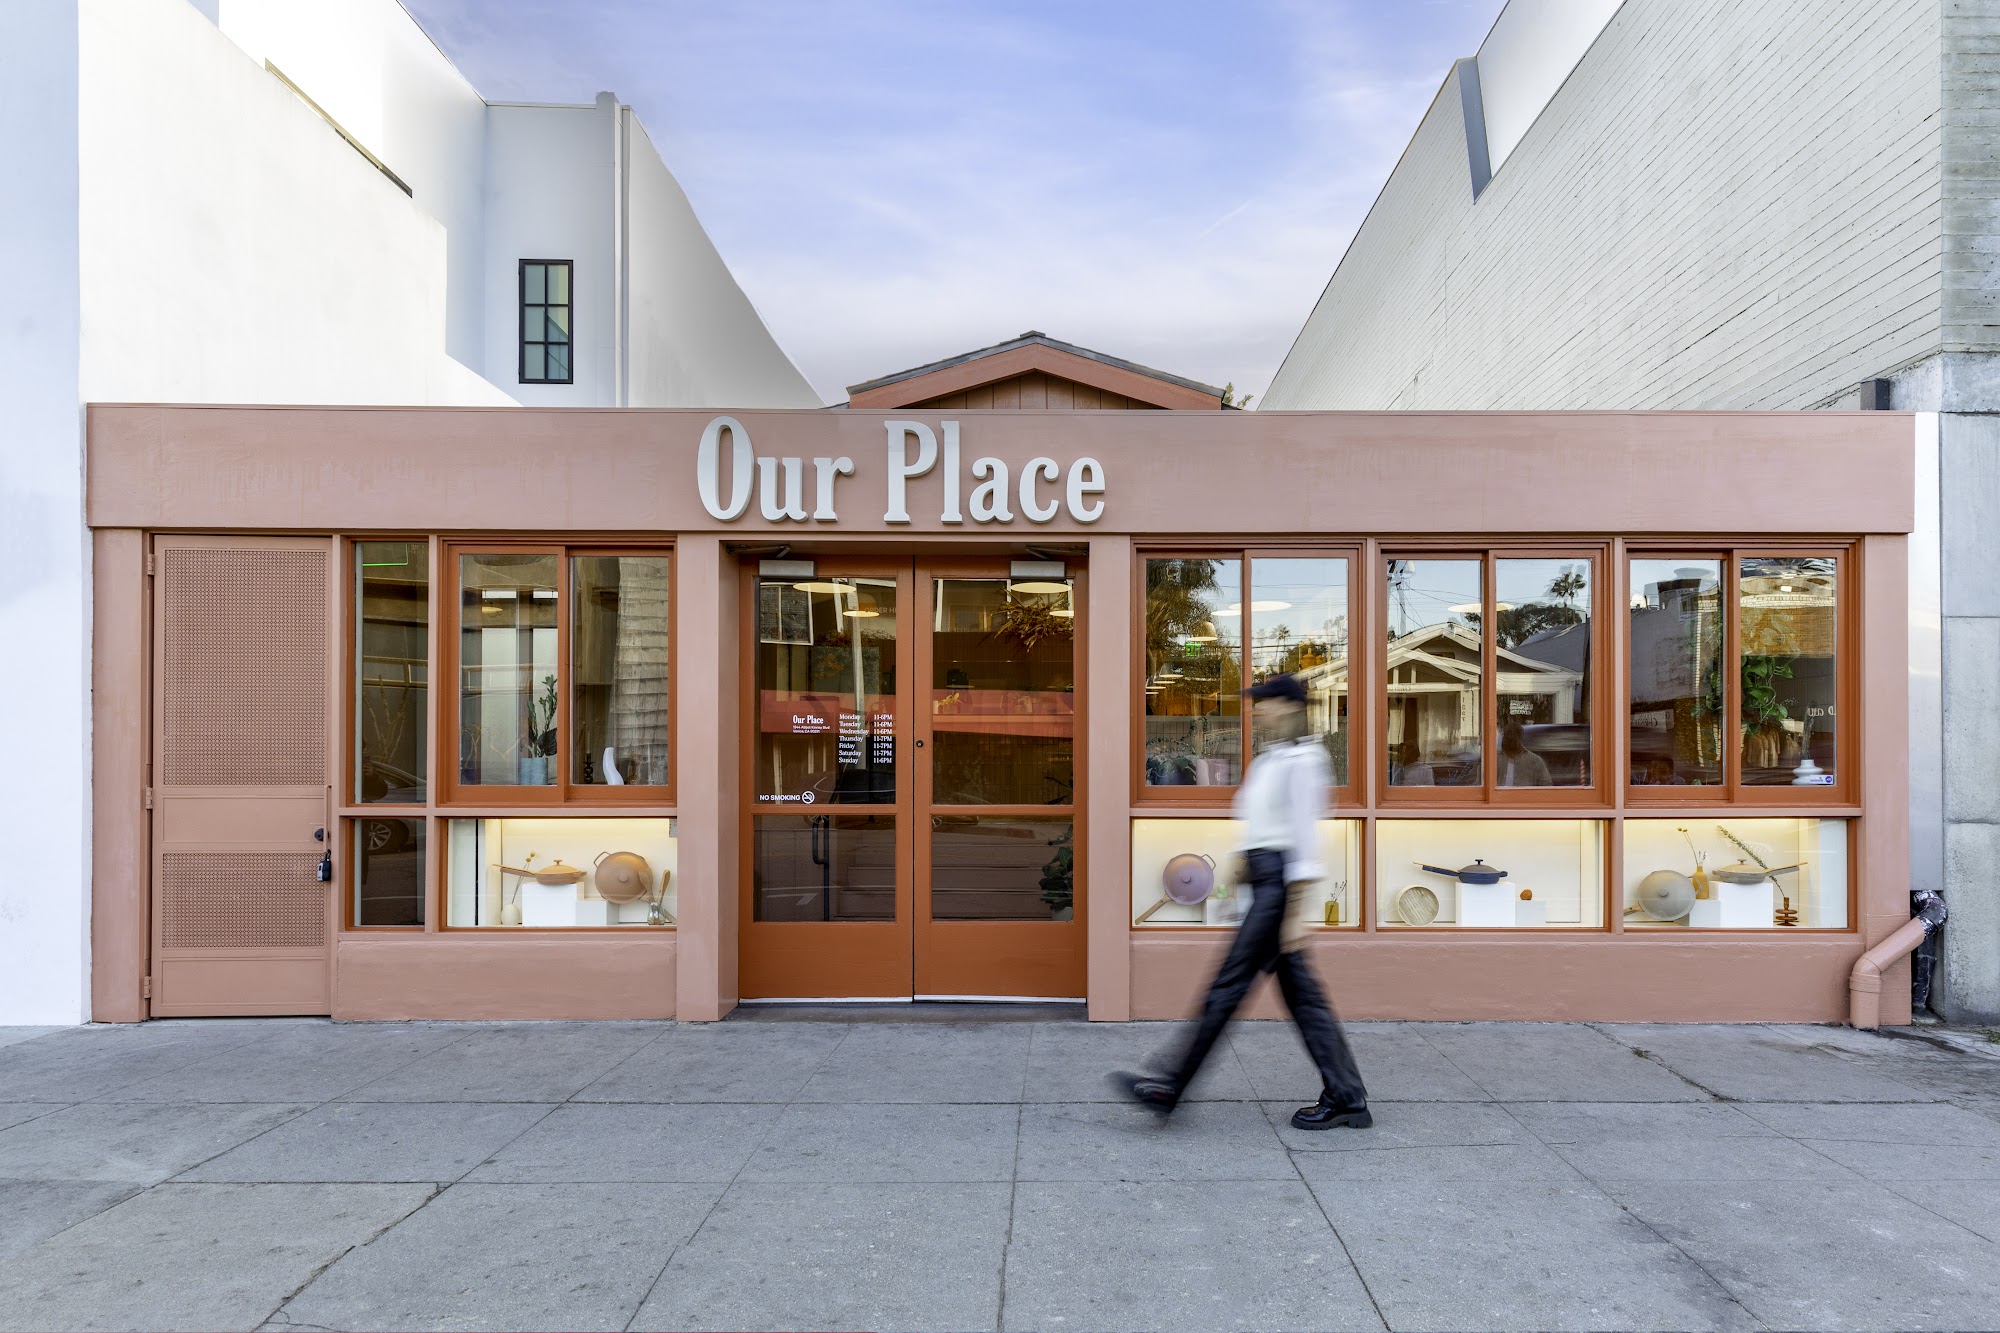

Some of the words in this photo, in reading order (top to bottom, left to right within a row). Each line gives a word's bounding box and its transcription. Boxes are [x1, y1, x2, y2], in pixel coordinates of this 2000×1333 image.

[697, 415, 856, 523] Our
[883, 420, 1106, 524] Place
[793, 714, 805, 724] Our
[807, 714, 824, 724] Place
[839, 742, 856, 750] Friday
